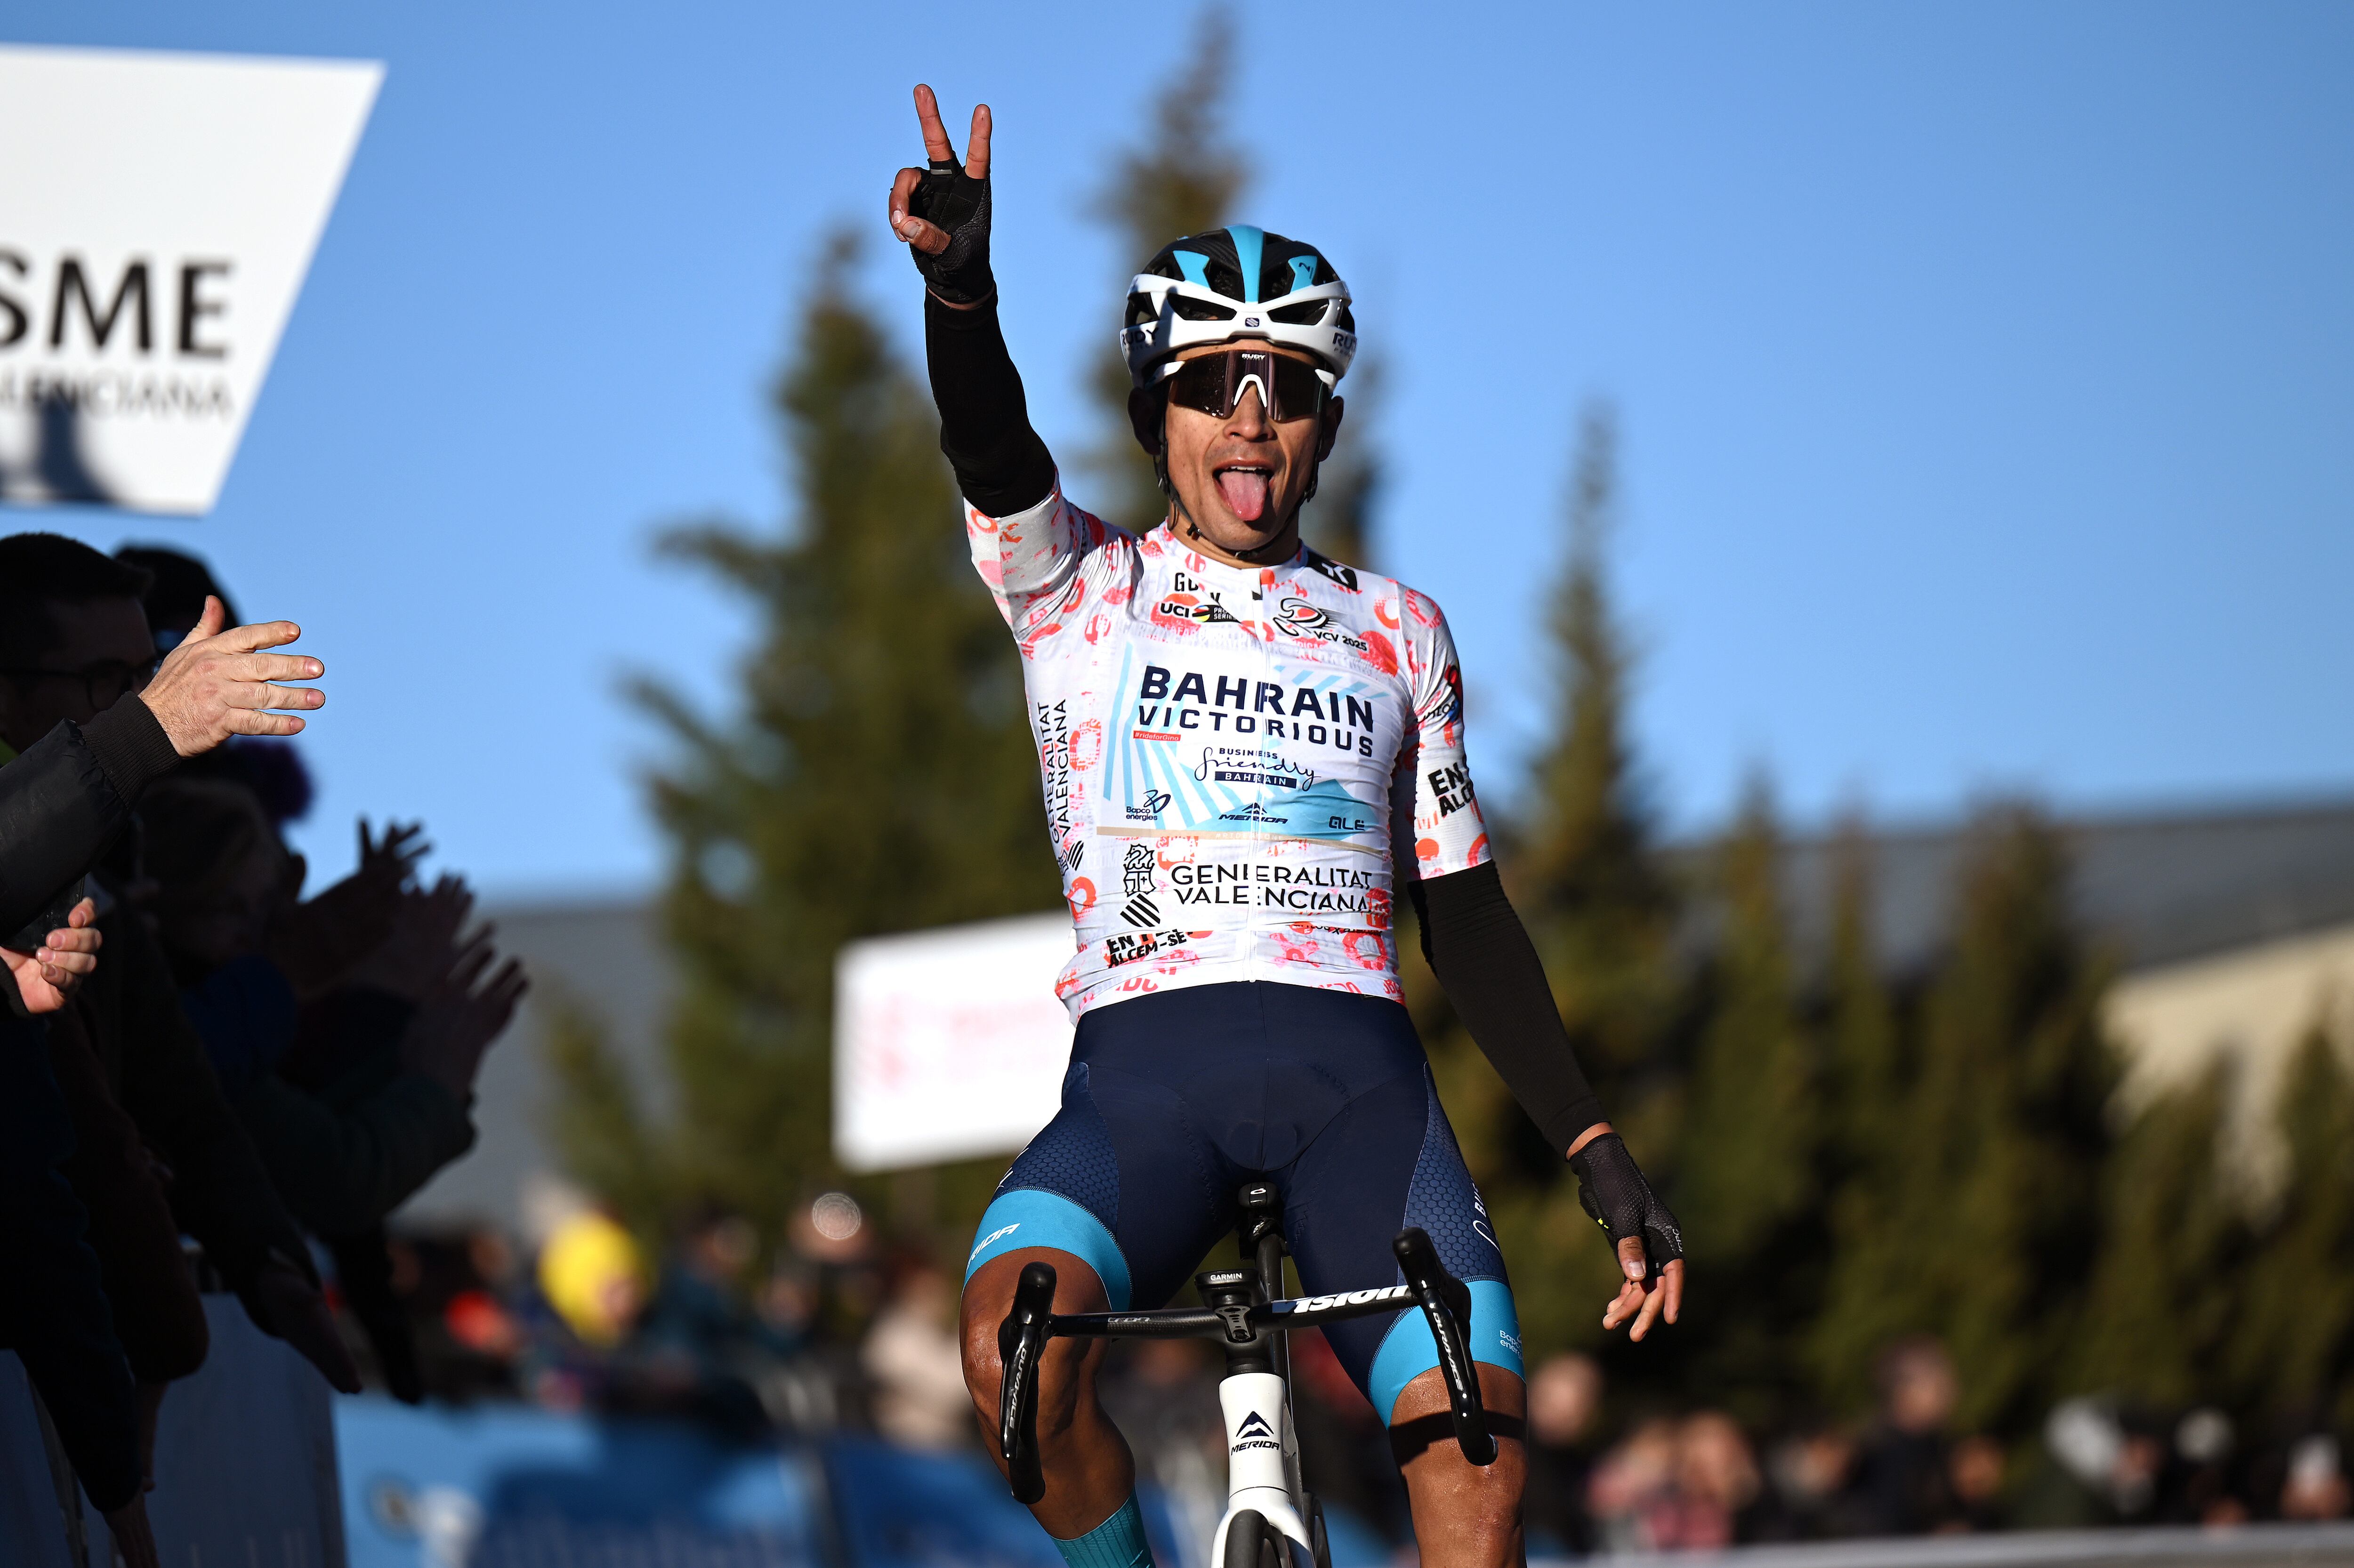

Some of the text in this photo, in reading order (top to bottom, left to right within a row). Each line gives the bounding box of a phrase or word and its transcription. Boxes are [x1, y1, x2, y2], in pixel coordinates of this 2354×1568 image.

[1161, 603, 1189, 618] UCI
[1314, 631, 1367, 651] VCV 2025
[1141, 666, 1373, 732] BAHRAIN
[1135, 732, 1178, 740] #rideforGino
[1139, 706, 1373, 757] VICTORIOUS
[1219, 748, 1278, 759] BUSINESS
[1038, 702, 1060, 844] GENERALITAT
[1054, 699, 1071, 838] VALENCIANA
[1225, 772, 1286, 786] BAHRAIN
[1127, 806, 1150, 815] Bapco
[1218, 813, 1289, 824] MERIDA
[1171, 864, 1372, 890] GENERALITAT
[1174, 885, 1371, 912] VALENCIANA
[1210, 1272, 1242, 1280] GARMIN
[1433, 1312, 1464, 1391] DURA-ACE
[1009, 1347, 1027, 1429] DURA-ACE
[1231, 1440, 1280, 1456] MERIDA
